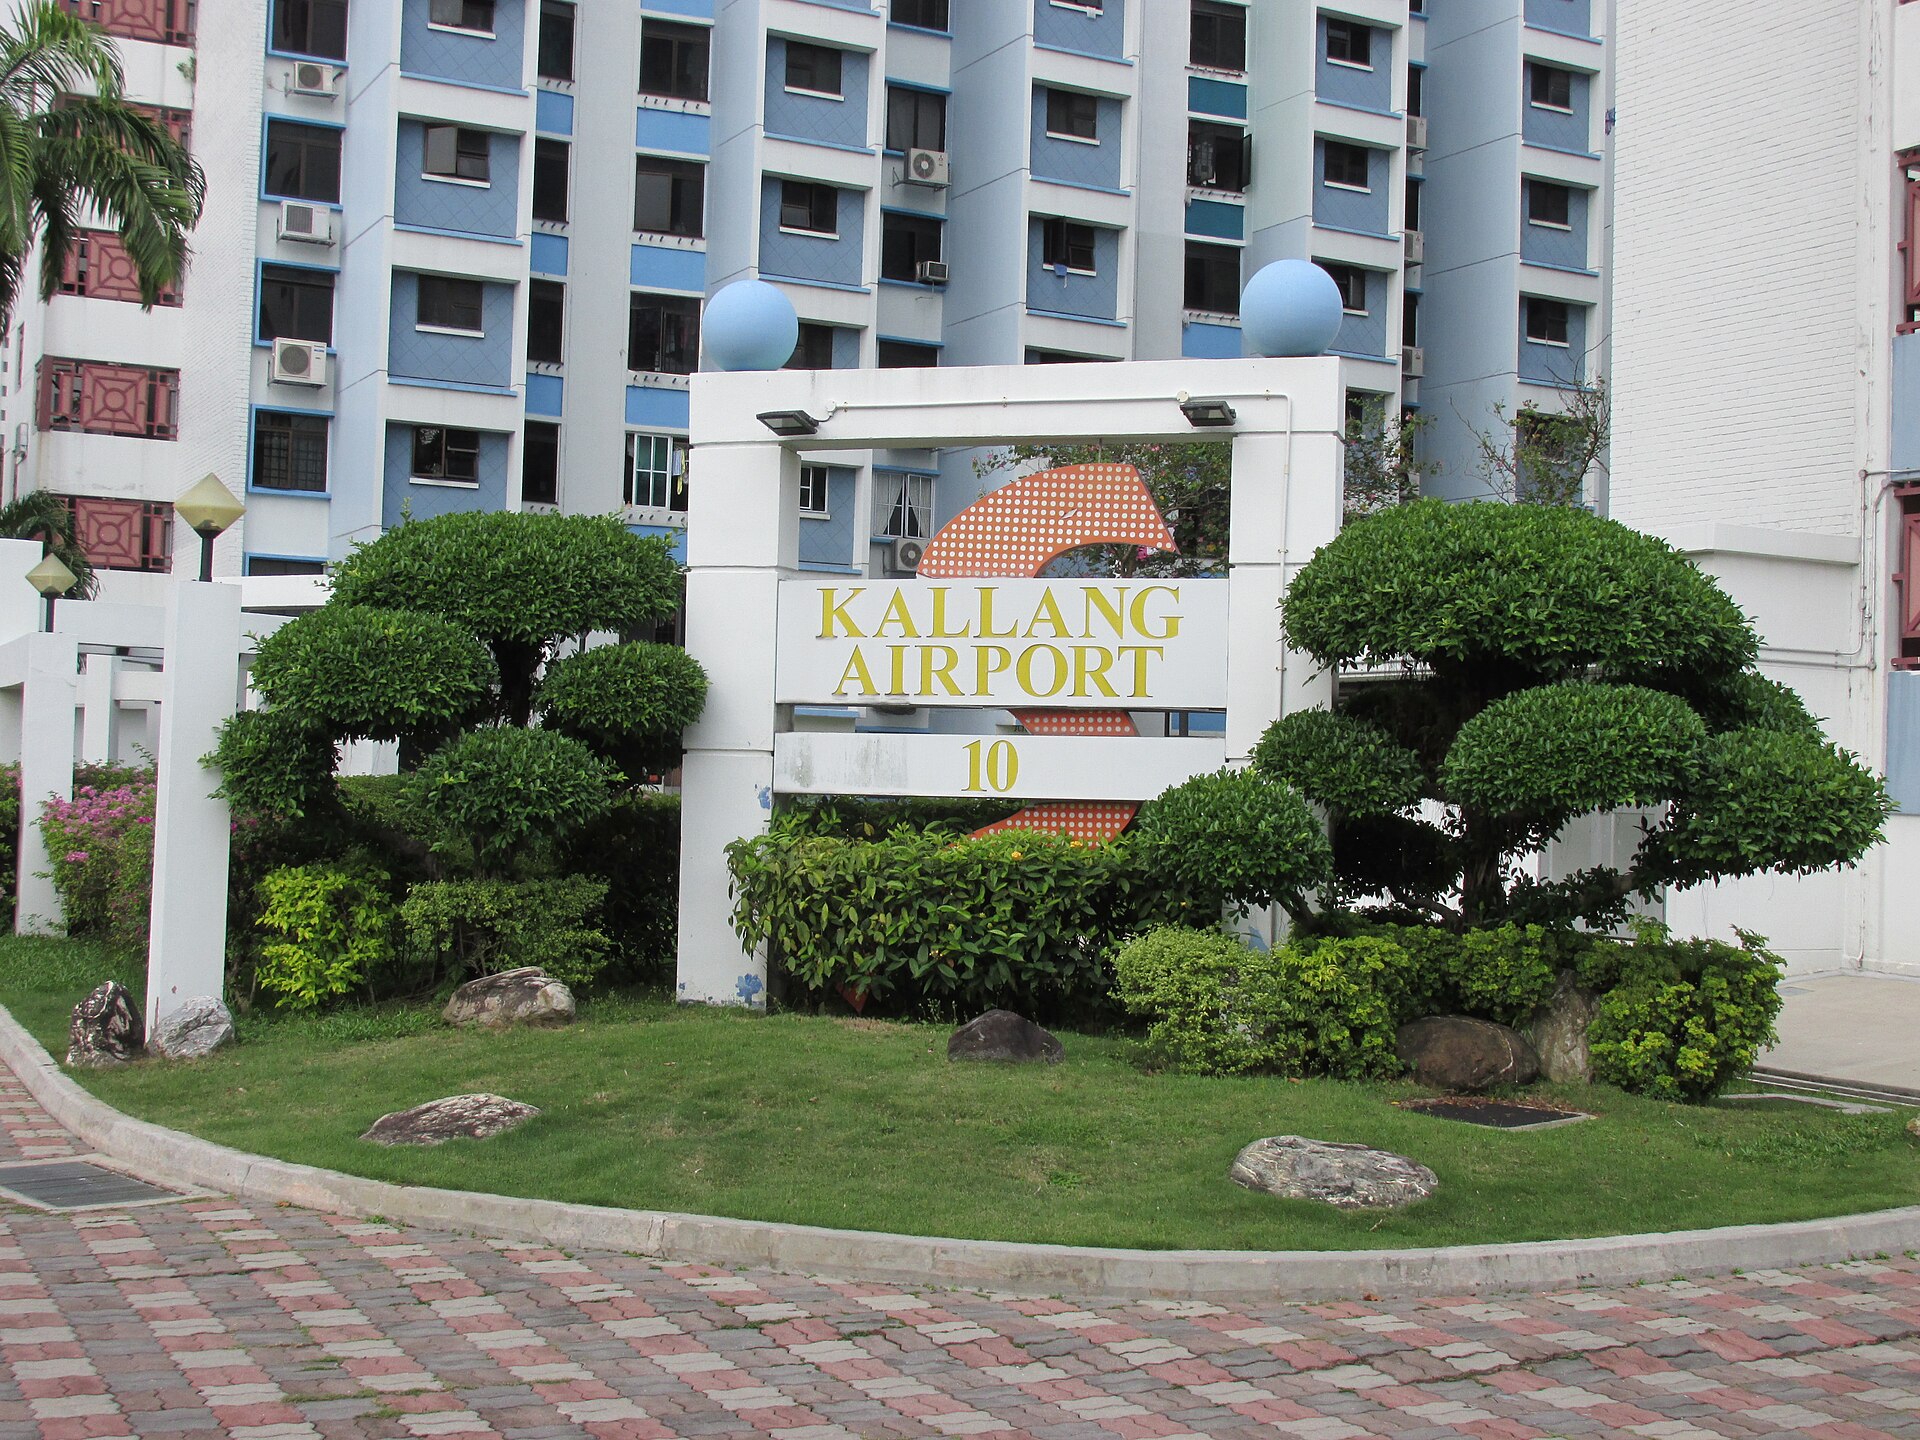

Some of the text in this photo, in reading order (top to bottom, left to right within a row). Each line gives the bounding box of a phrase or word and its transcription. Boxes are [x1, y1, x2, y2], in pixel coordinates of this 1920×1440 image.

[816, 586, 1184, 639] KALLANG
[832, 643, 1164, 698] AIRPORT
[961, 739, 1019, 792] 10
